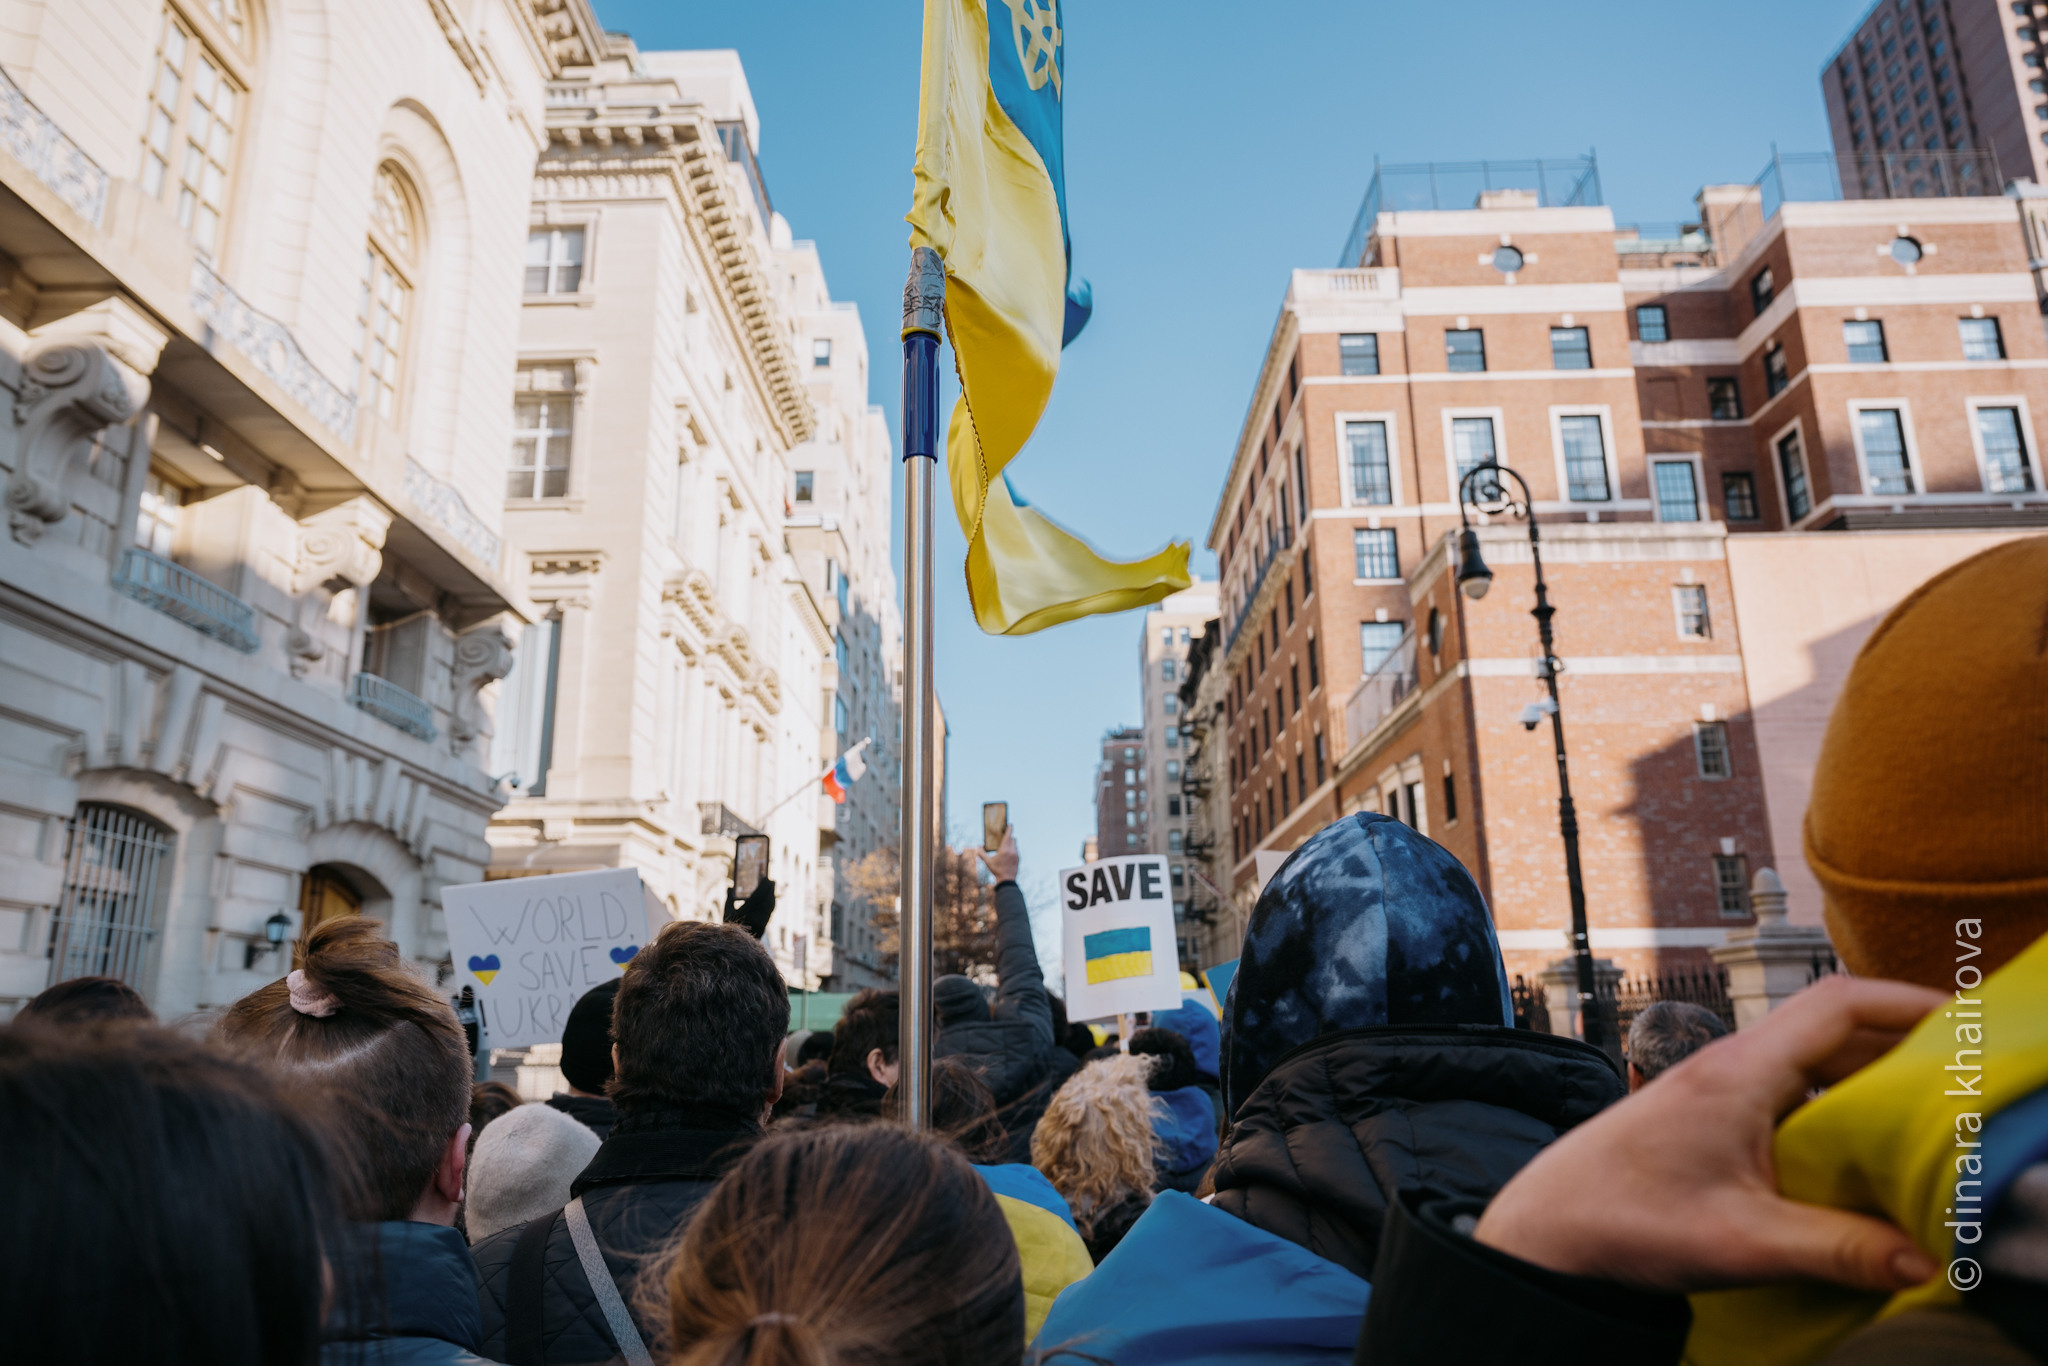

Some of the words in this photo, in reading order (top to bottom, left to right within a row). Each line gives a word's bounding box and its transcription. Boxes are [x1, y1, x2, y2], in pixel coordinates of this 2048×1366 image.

[1066, 863, 1164, 911] SAVE
[469, 891, 635, 946] WORLD,
[518, 945, 600, 991] SAVE
